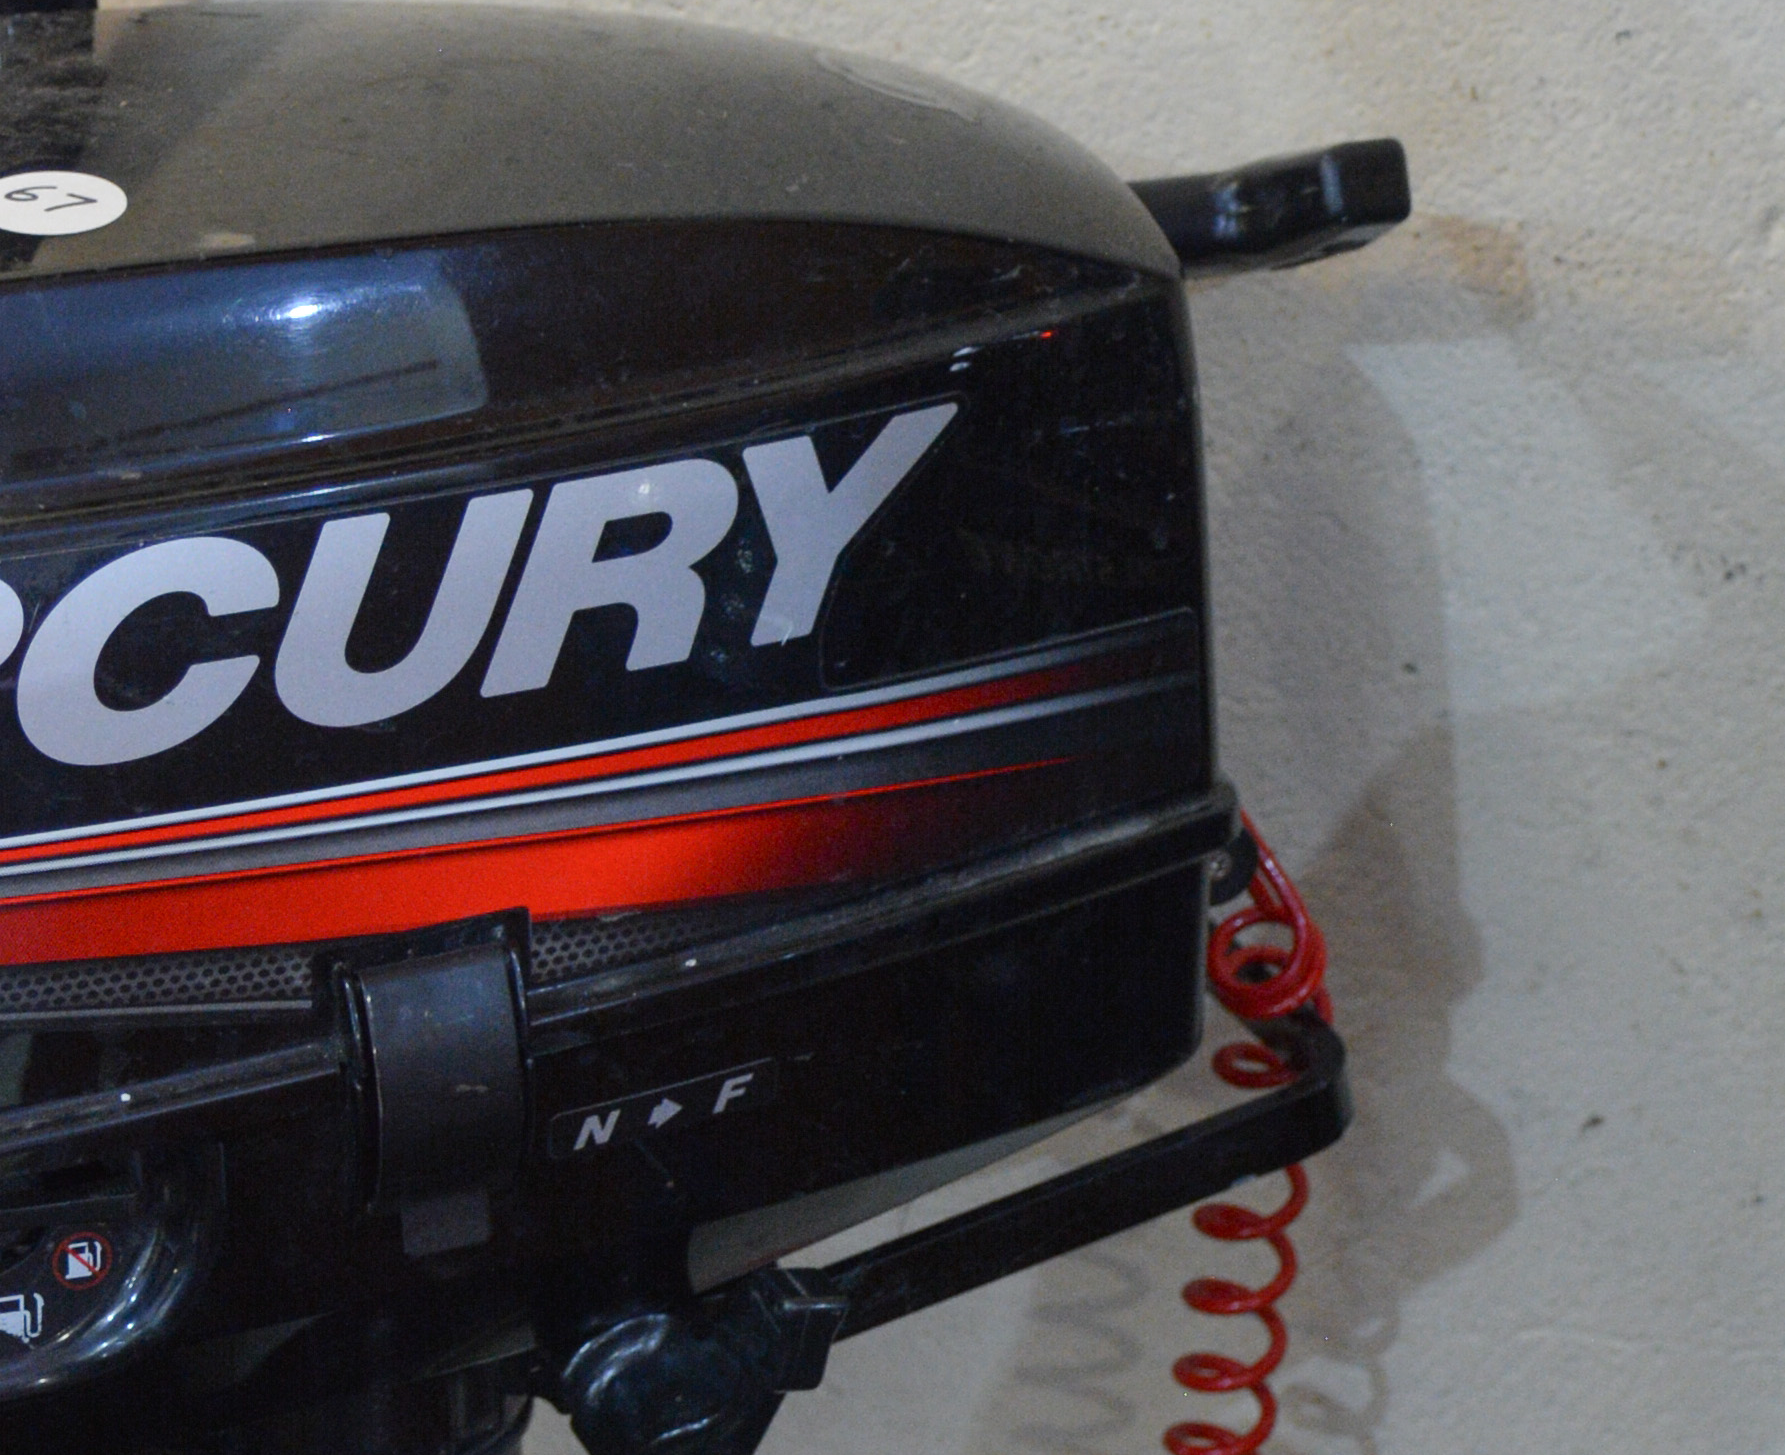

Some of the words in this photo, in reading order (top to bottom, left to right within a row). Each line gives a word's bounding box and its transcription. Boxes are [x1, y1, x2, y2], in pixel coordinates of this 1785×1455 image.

[3, 184, 99, 213] 67
[573, 1109, 621, 1151] N
[712, 1072, 754, 1114] F
